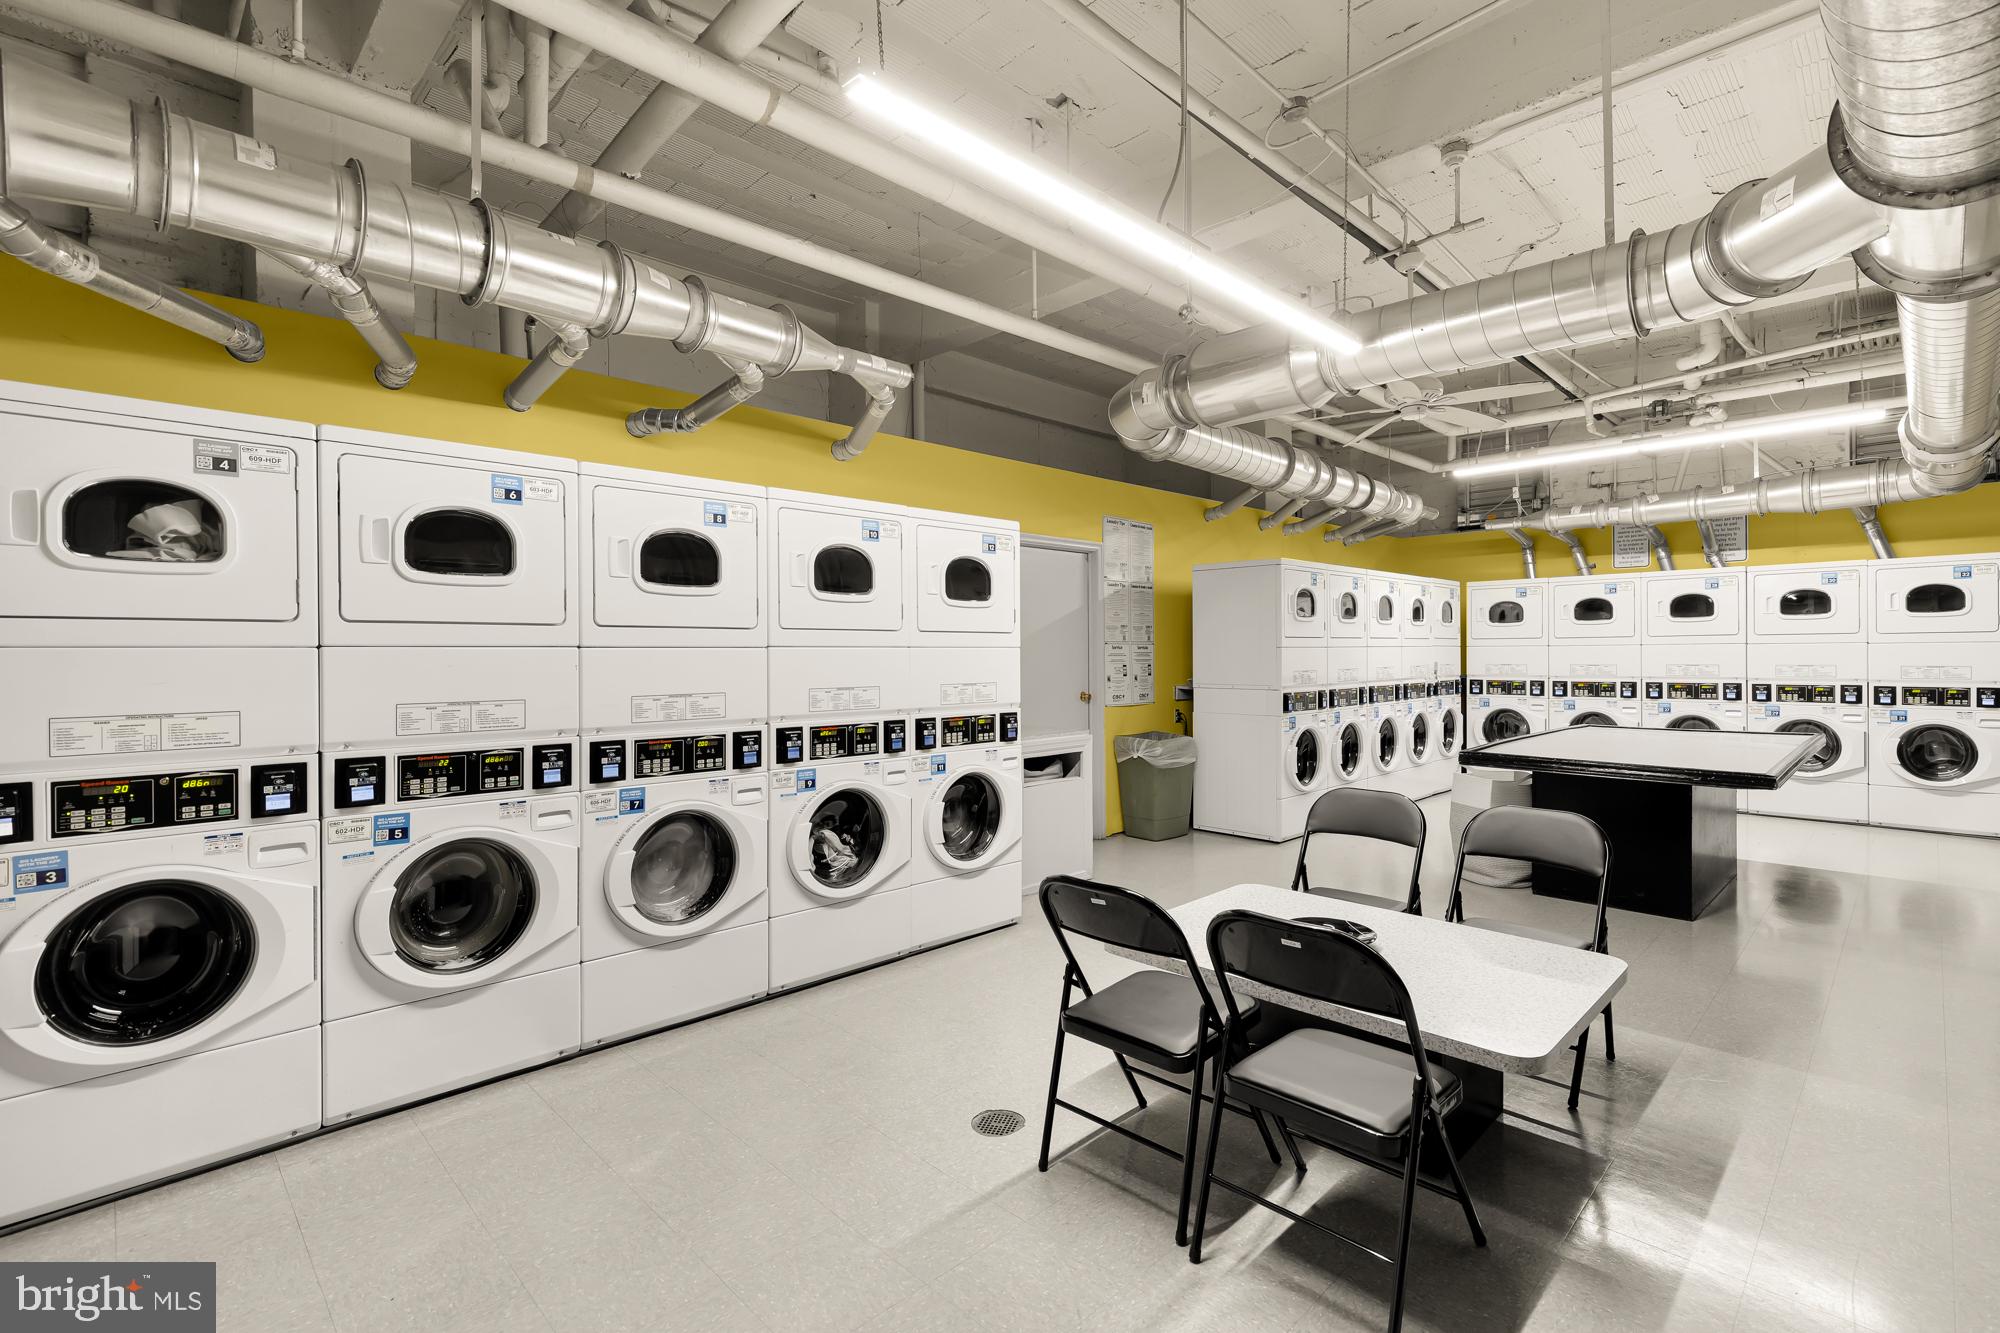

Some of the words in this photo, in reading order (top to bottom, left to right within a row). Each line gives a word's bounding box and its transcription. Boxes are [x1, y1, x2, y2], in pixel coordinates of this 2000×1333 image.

[219, 460, 230, 470] 4
[510, 490, 516, 499] 6
[114, 785, 128, 793] 20
[394, 829, 402, 838] 5
[45, 871, 57, 883] 3
